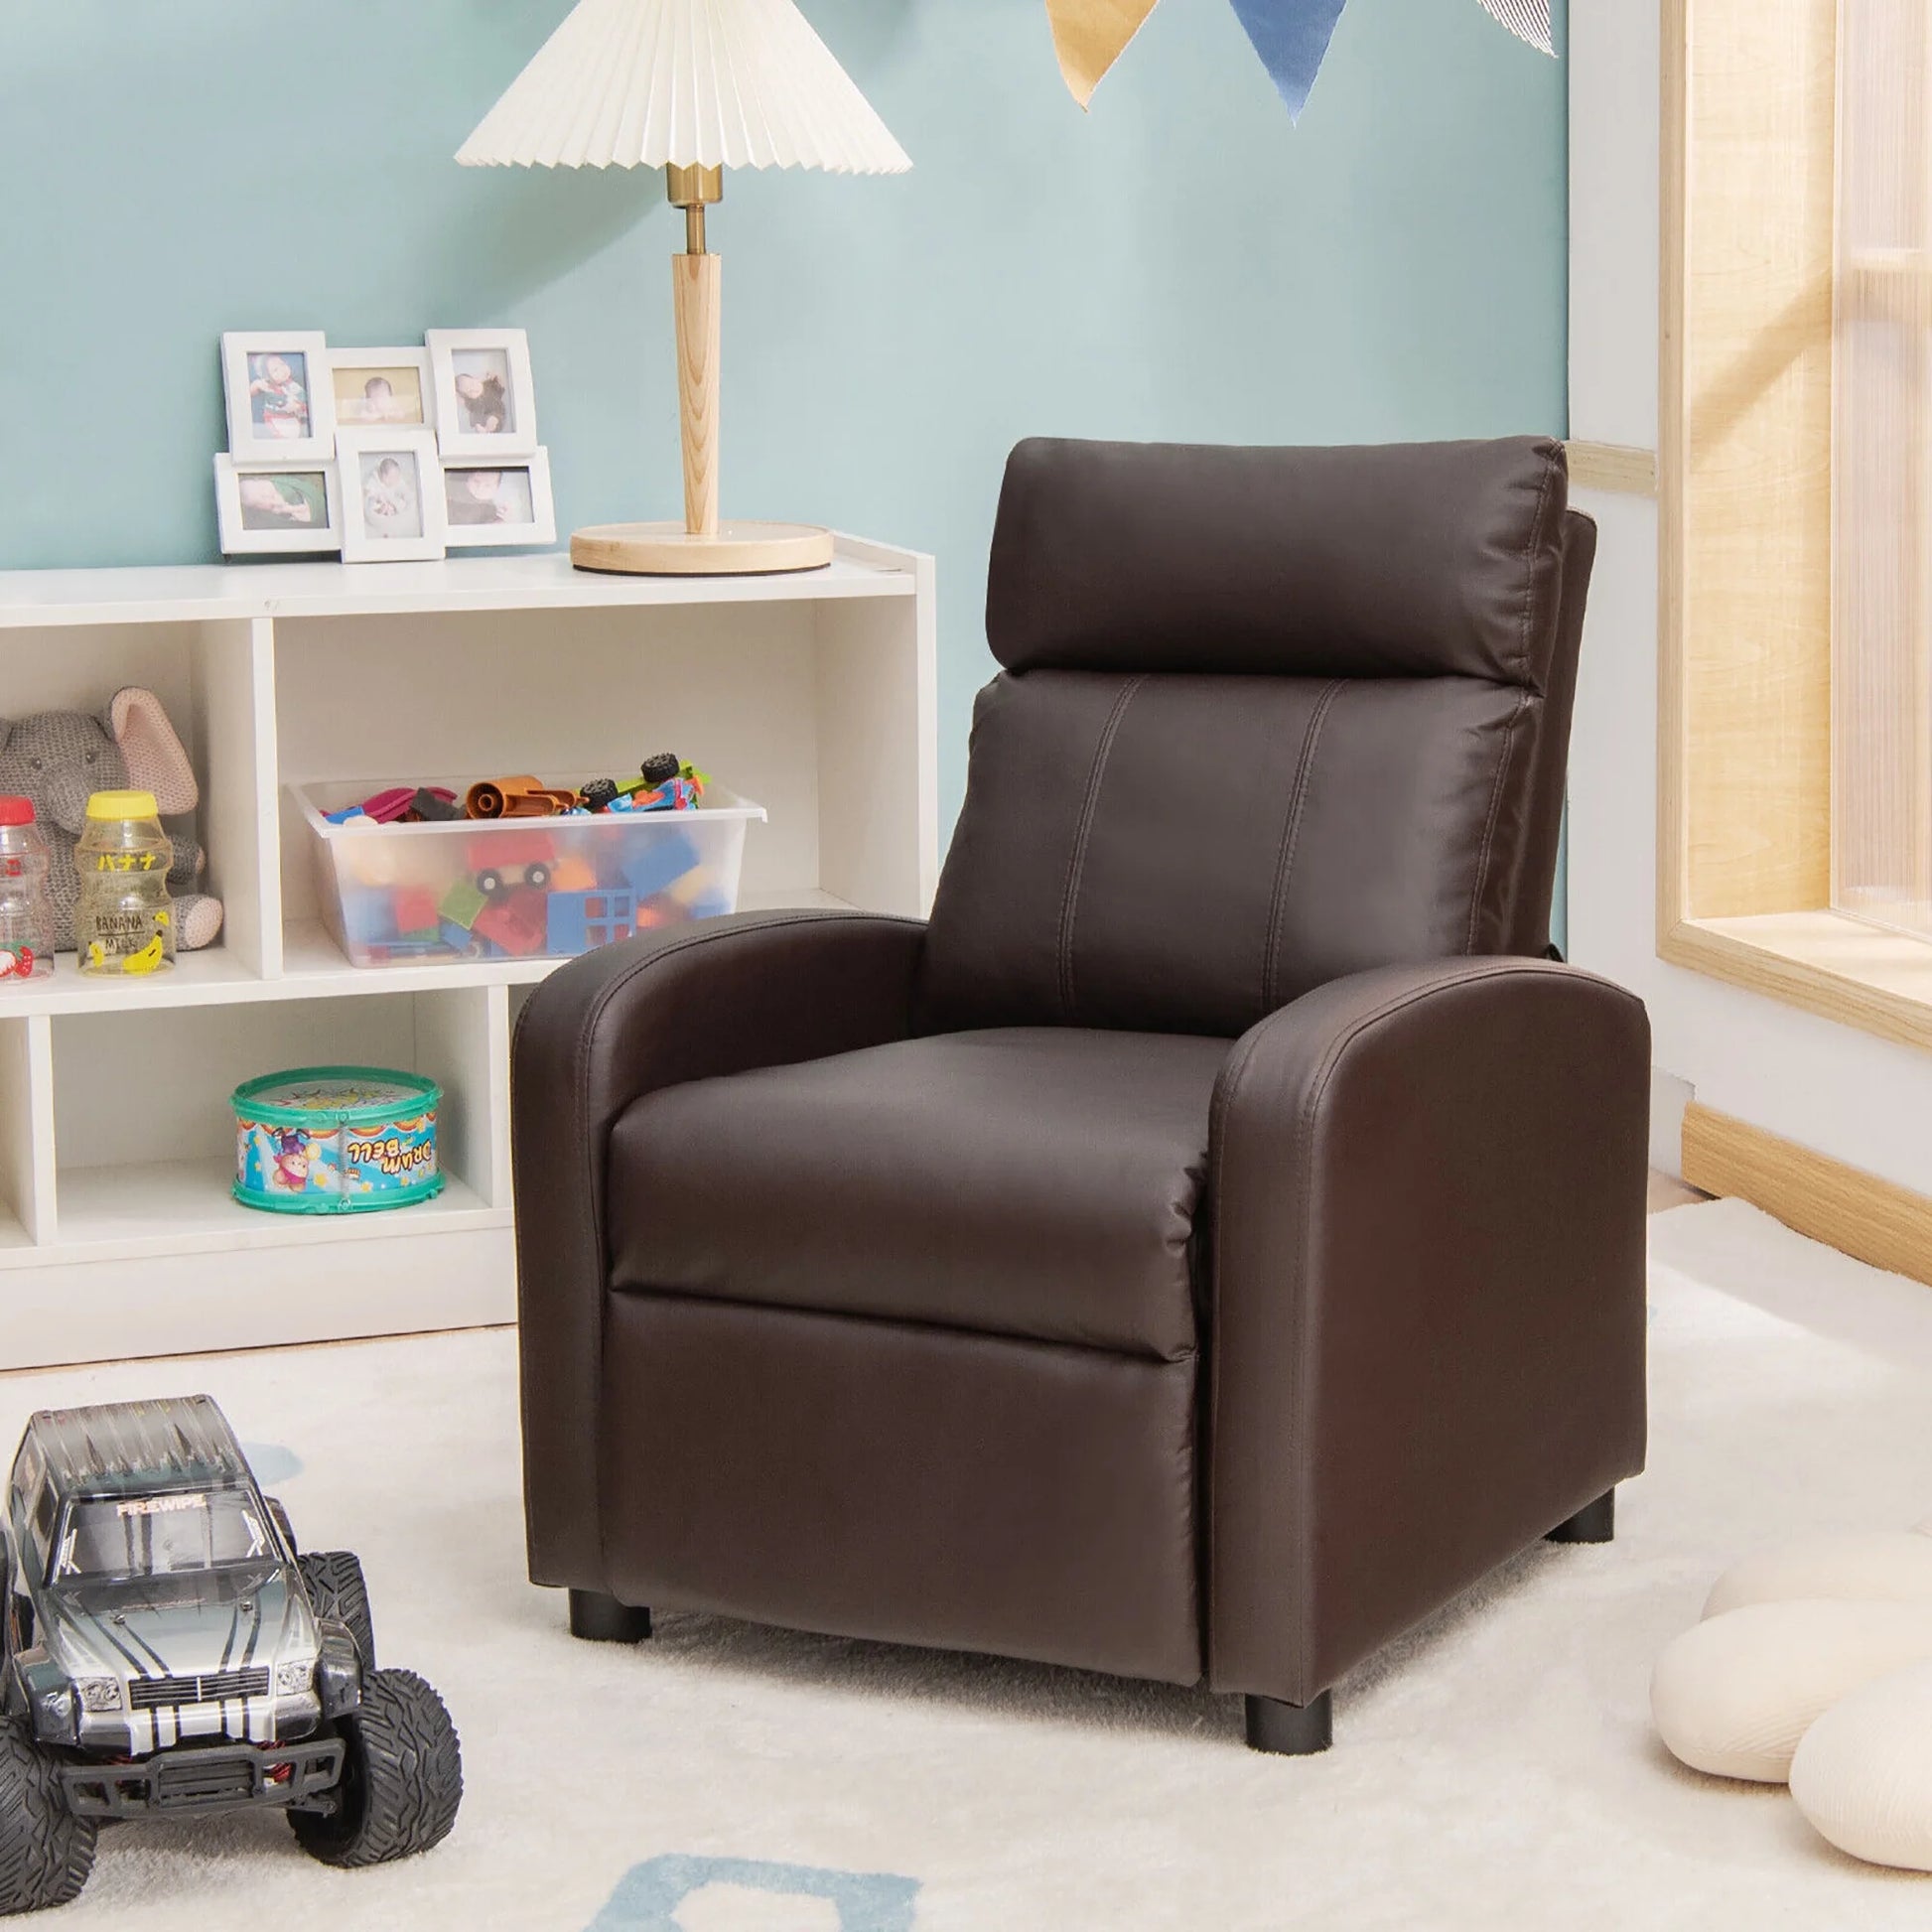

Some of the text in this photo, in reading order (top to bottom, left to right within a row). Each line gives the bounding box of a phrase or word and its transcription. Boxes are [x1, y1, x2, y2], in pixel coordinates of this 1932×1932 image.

[96, 915, 143, 931] BANANA
[347, 1137, 401, 1164] BELL
[381, 1138, 432, 1174] DRUM
